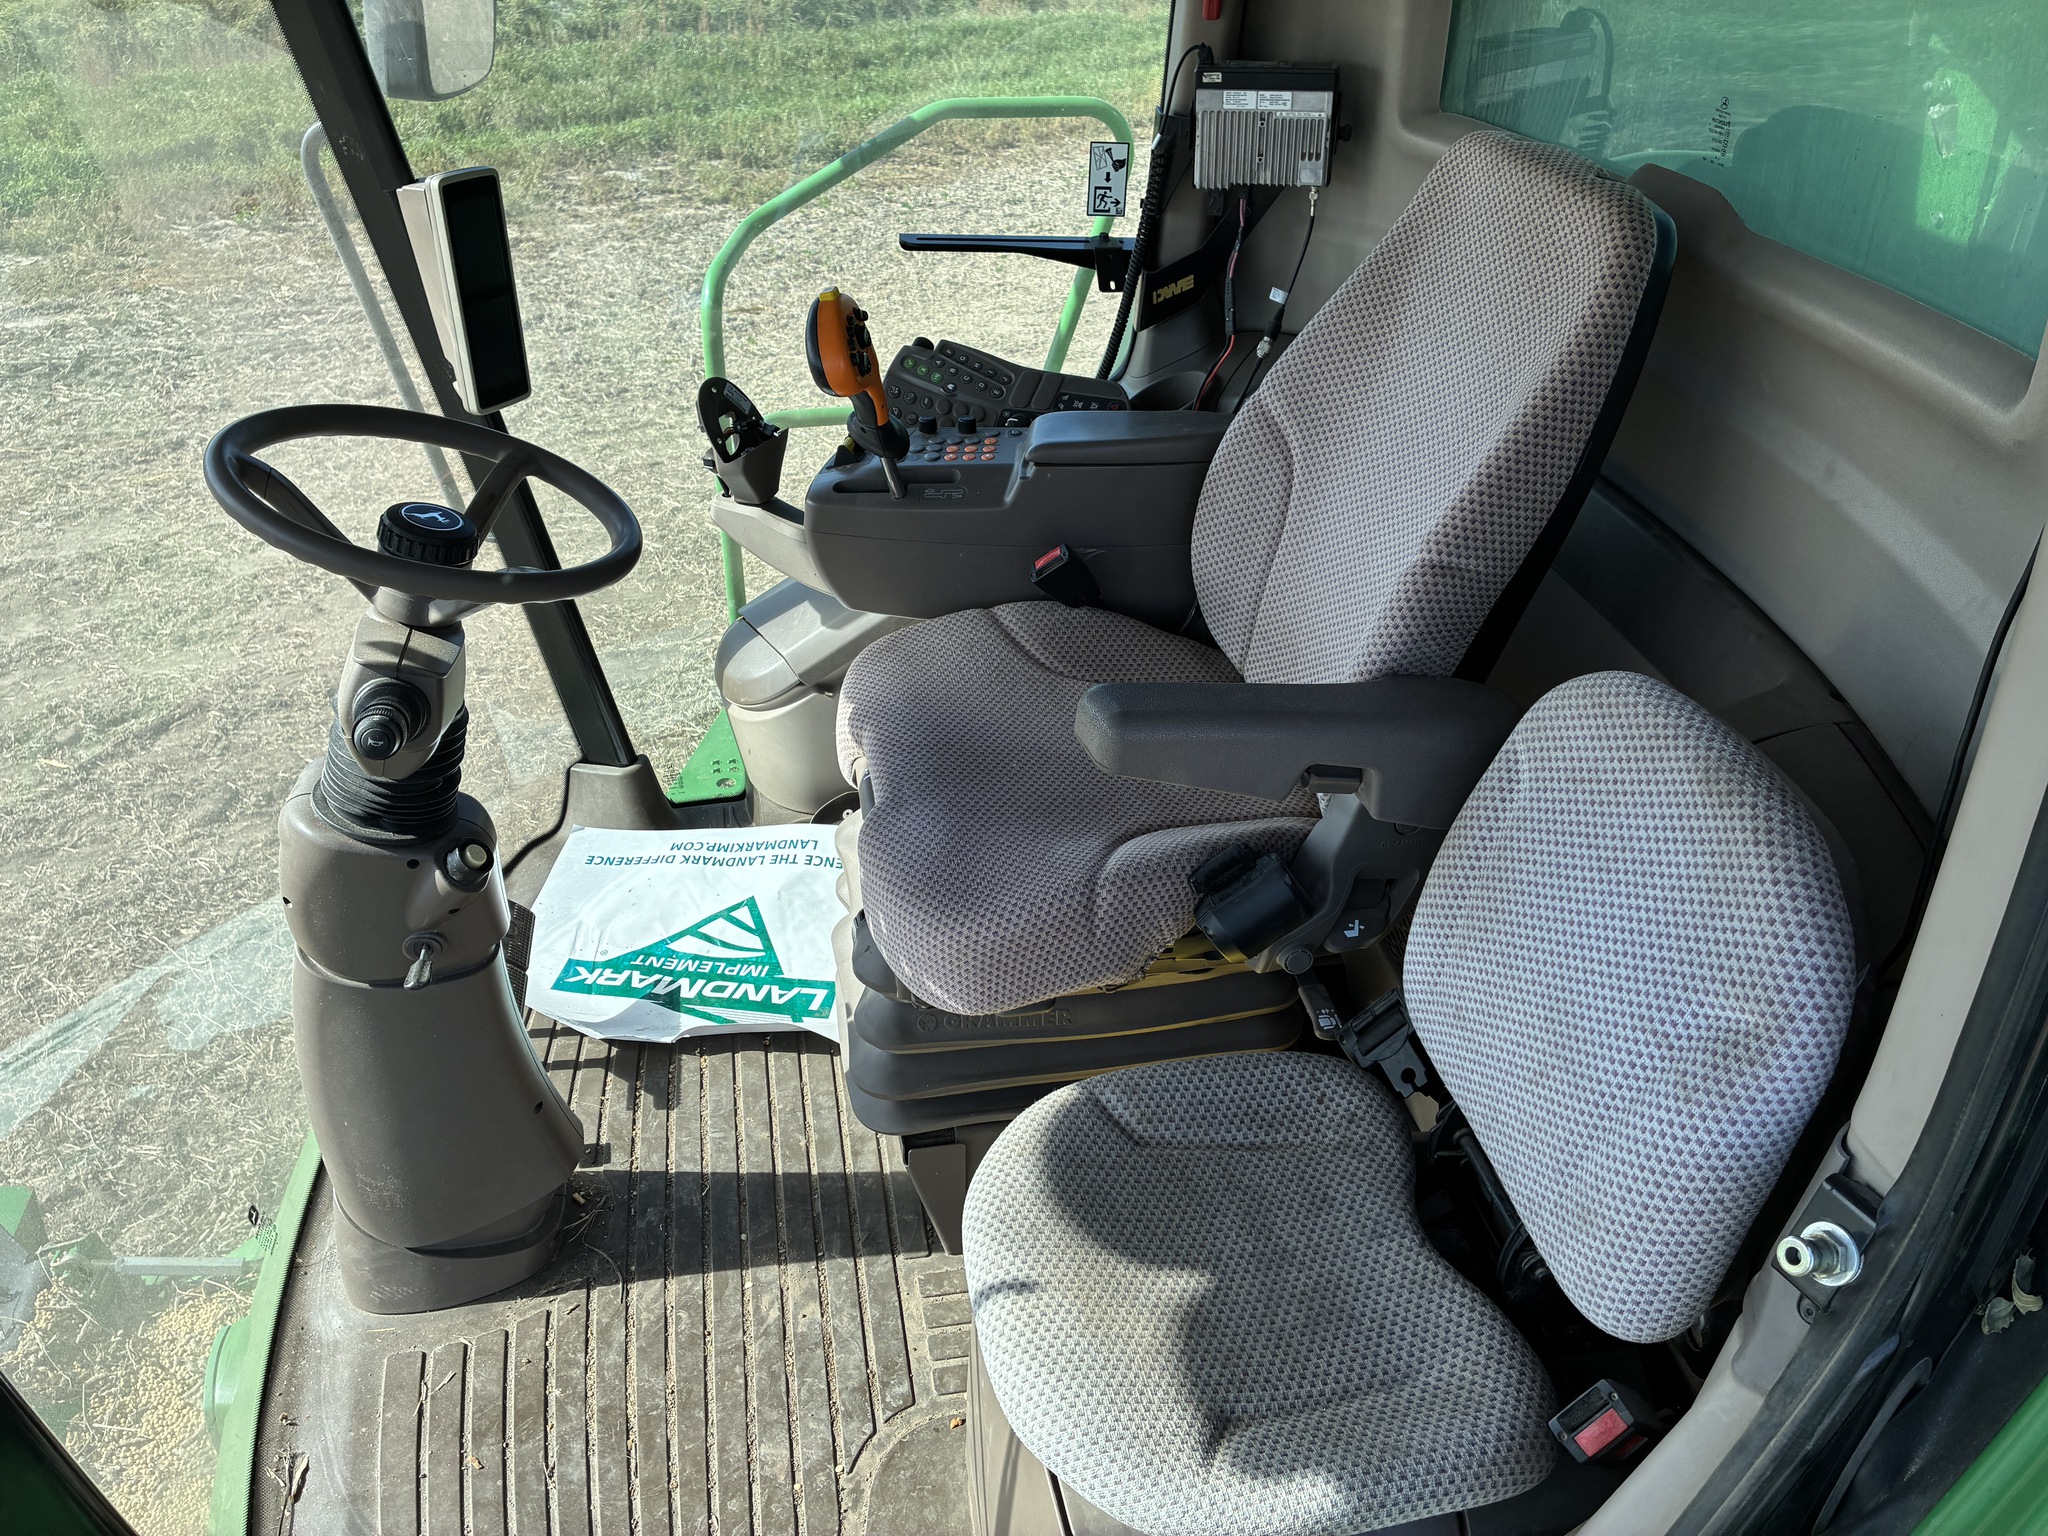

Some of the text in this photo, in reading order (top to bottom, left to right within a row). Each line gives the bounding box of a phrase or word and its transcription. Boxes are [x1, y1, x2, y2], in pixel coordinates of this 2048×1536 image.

[670, 839, 819, 853] LANDMARKIMP.COM
[584, 855, 677, 866] DIFFERENCE
[679, 854, 766, 867] LANDMARK
[769, 854, 799, 865] THE
[630, 954, 770, 977] IMPLEMENT
[564, 965, 829, 1012] LANDMARK
